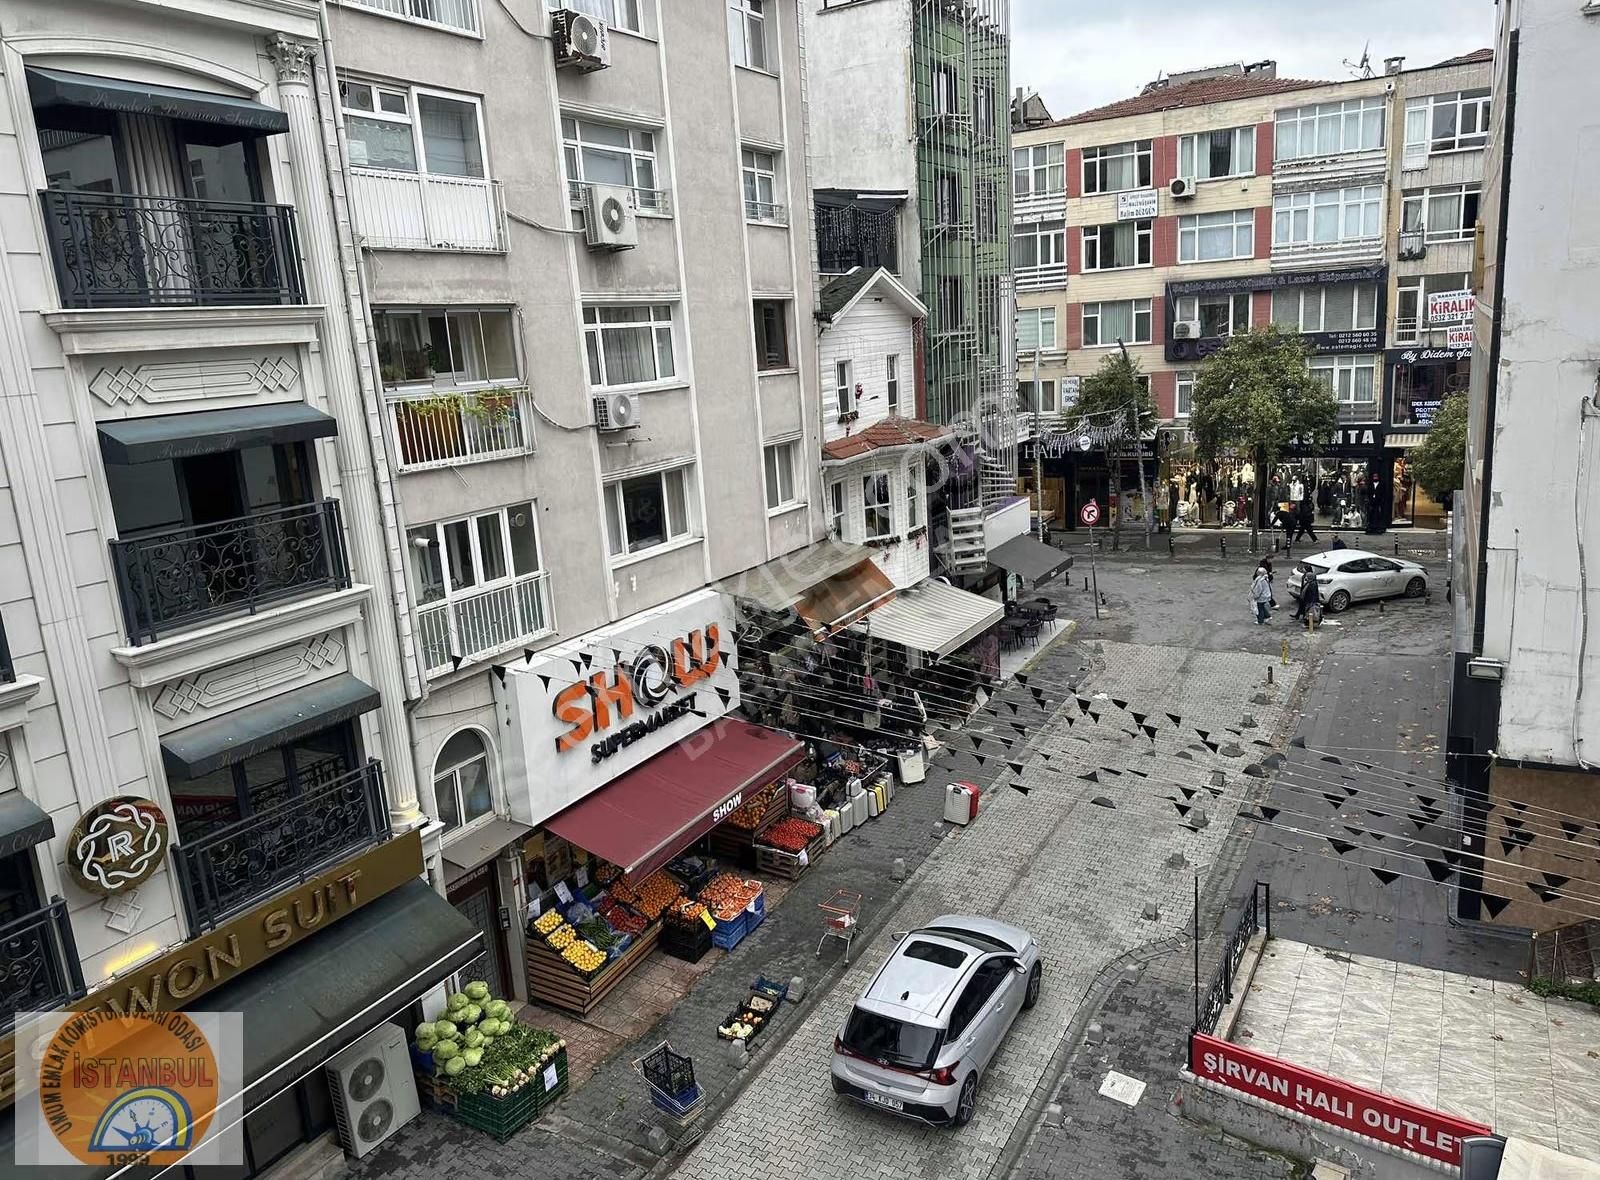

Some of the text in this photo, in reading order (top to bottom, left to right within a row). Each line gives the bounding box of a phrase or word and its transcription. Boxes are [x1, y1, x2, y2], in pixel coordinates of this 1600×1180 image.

[1419, 349, 1454, 359] Didem
[552, 622, 720, 753] SHOW
[591, 692, 698, 765] SUPERMARKET
[712, 792, 743, 823] SHOW
[262, 870, 363, 950] SUIT
[1203, 1052, 1288, 1097] ŞİRVAN
[1296, 1083, 1353, 1119] HALI
